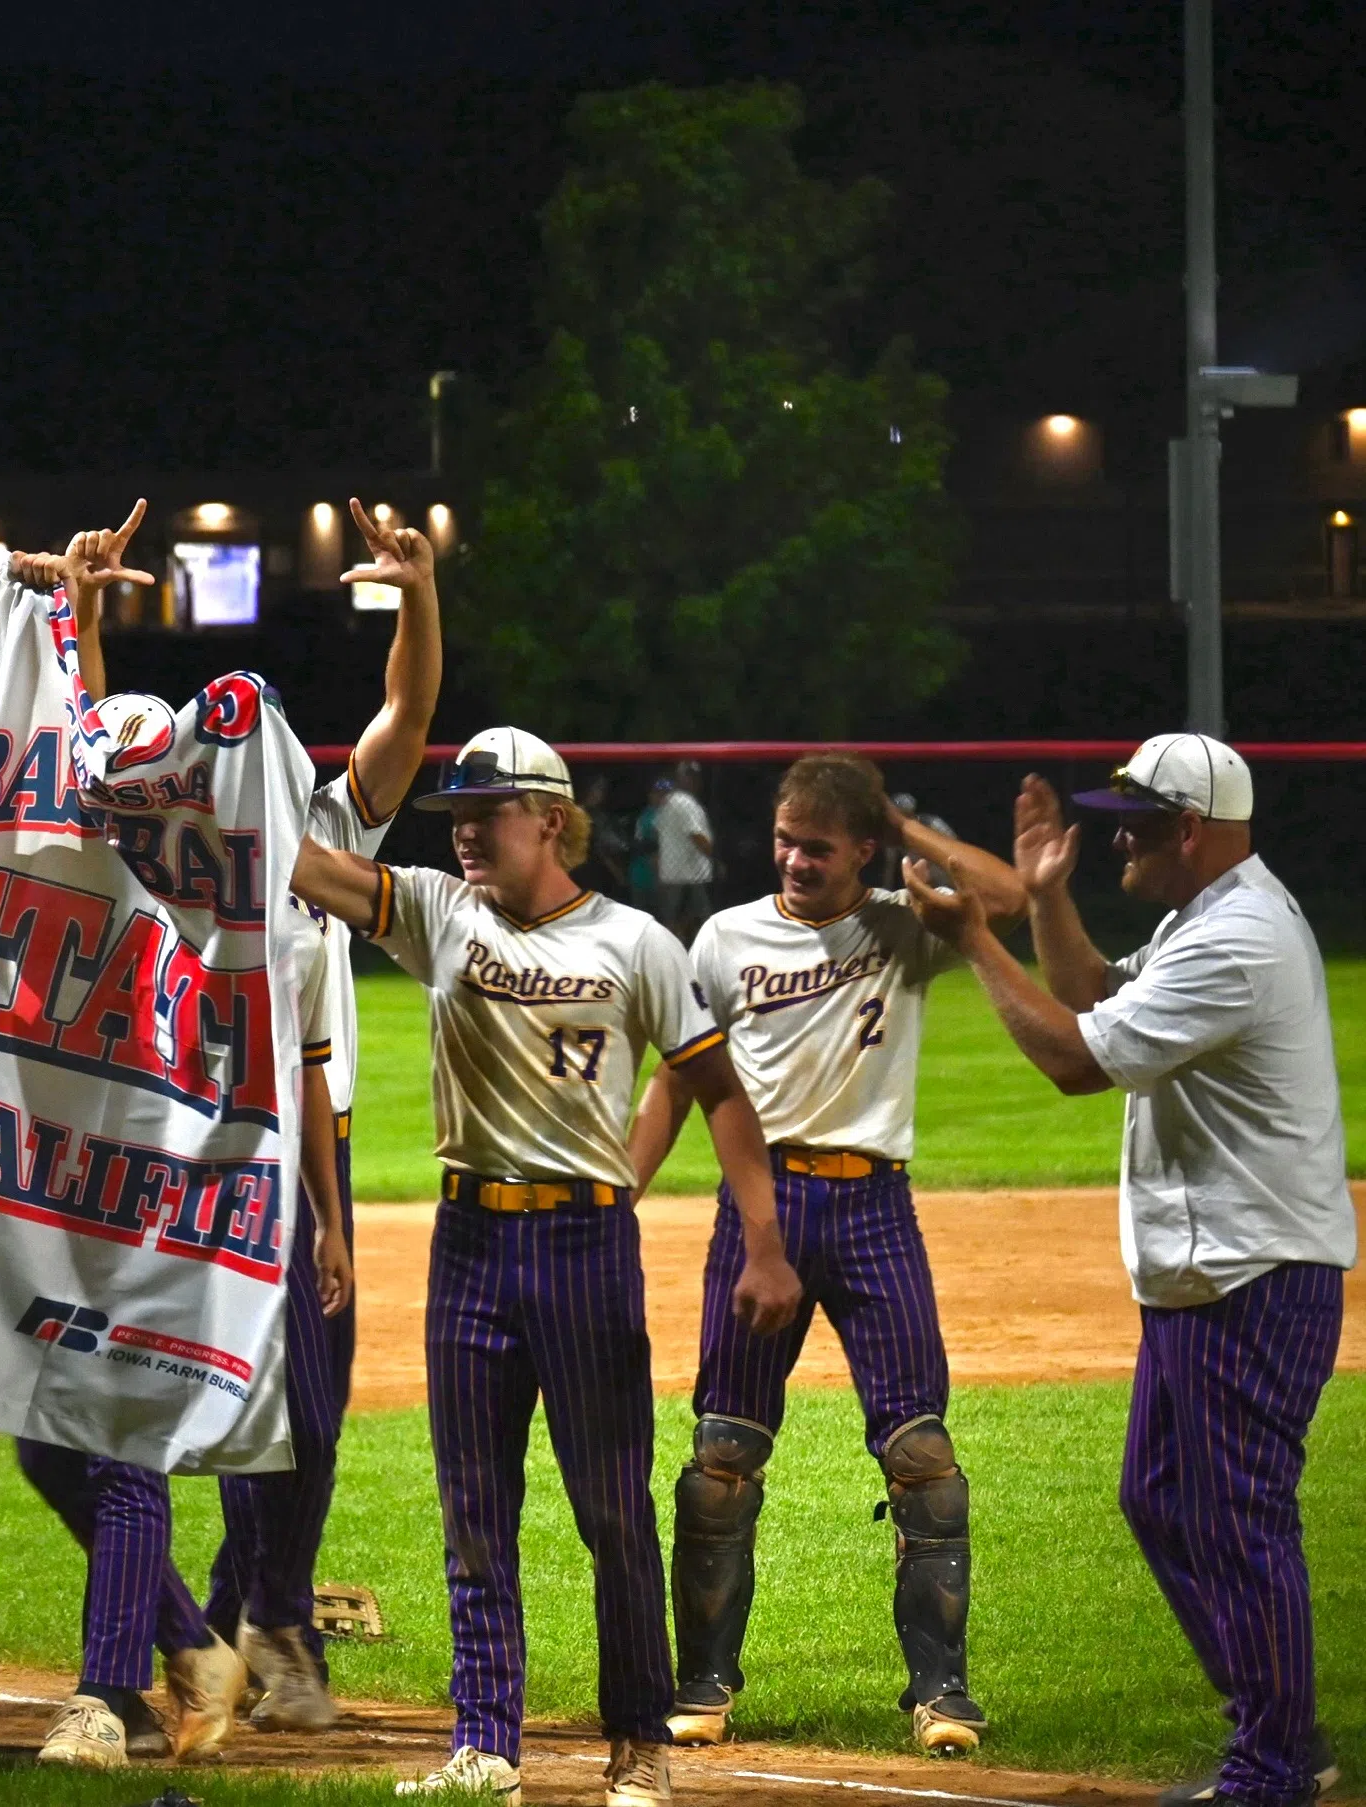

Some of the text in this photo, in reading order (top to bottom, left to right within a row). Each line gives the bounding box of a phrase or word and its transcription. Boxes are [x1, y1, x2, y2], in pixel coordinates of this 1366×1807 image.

[466, 939, 615, 999] Panthers
[857, 995, 885, 1050] 2
[548, 1026, 609, 1084] 17
[107, 1349, 152, 1369] IOWA
[155, 1358, 208, 1381] FARM
